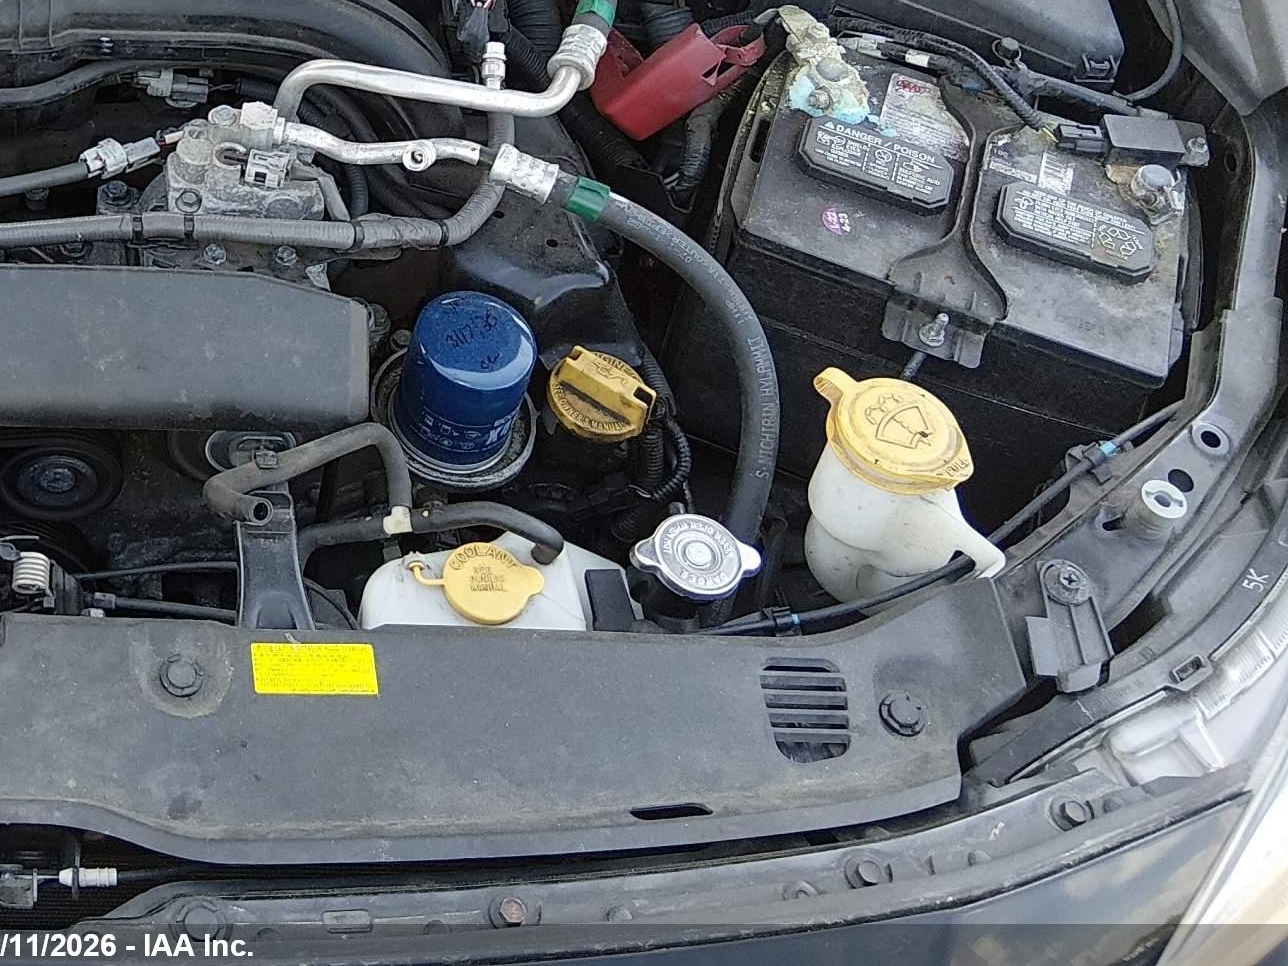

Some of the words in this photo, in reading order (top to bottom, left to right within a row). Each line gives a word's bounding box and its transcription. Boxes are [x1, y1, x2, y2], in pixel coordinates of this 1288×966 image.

[836, 124, 882, 145] DANGER
[893, 143, 935, 163] POISON
[450, 544, 519, 571] COOLANT
